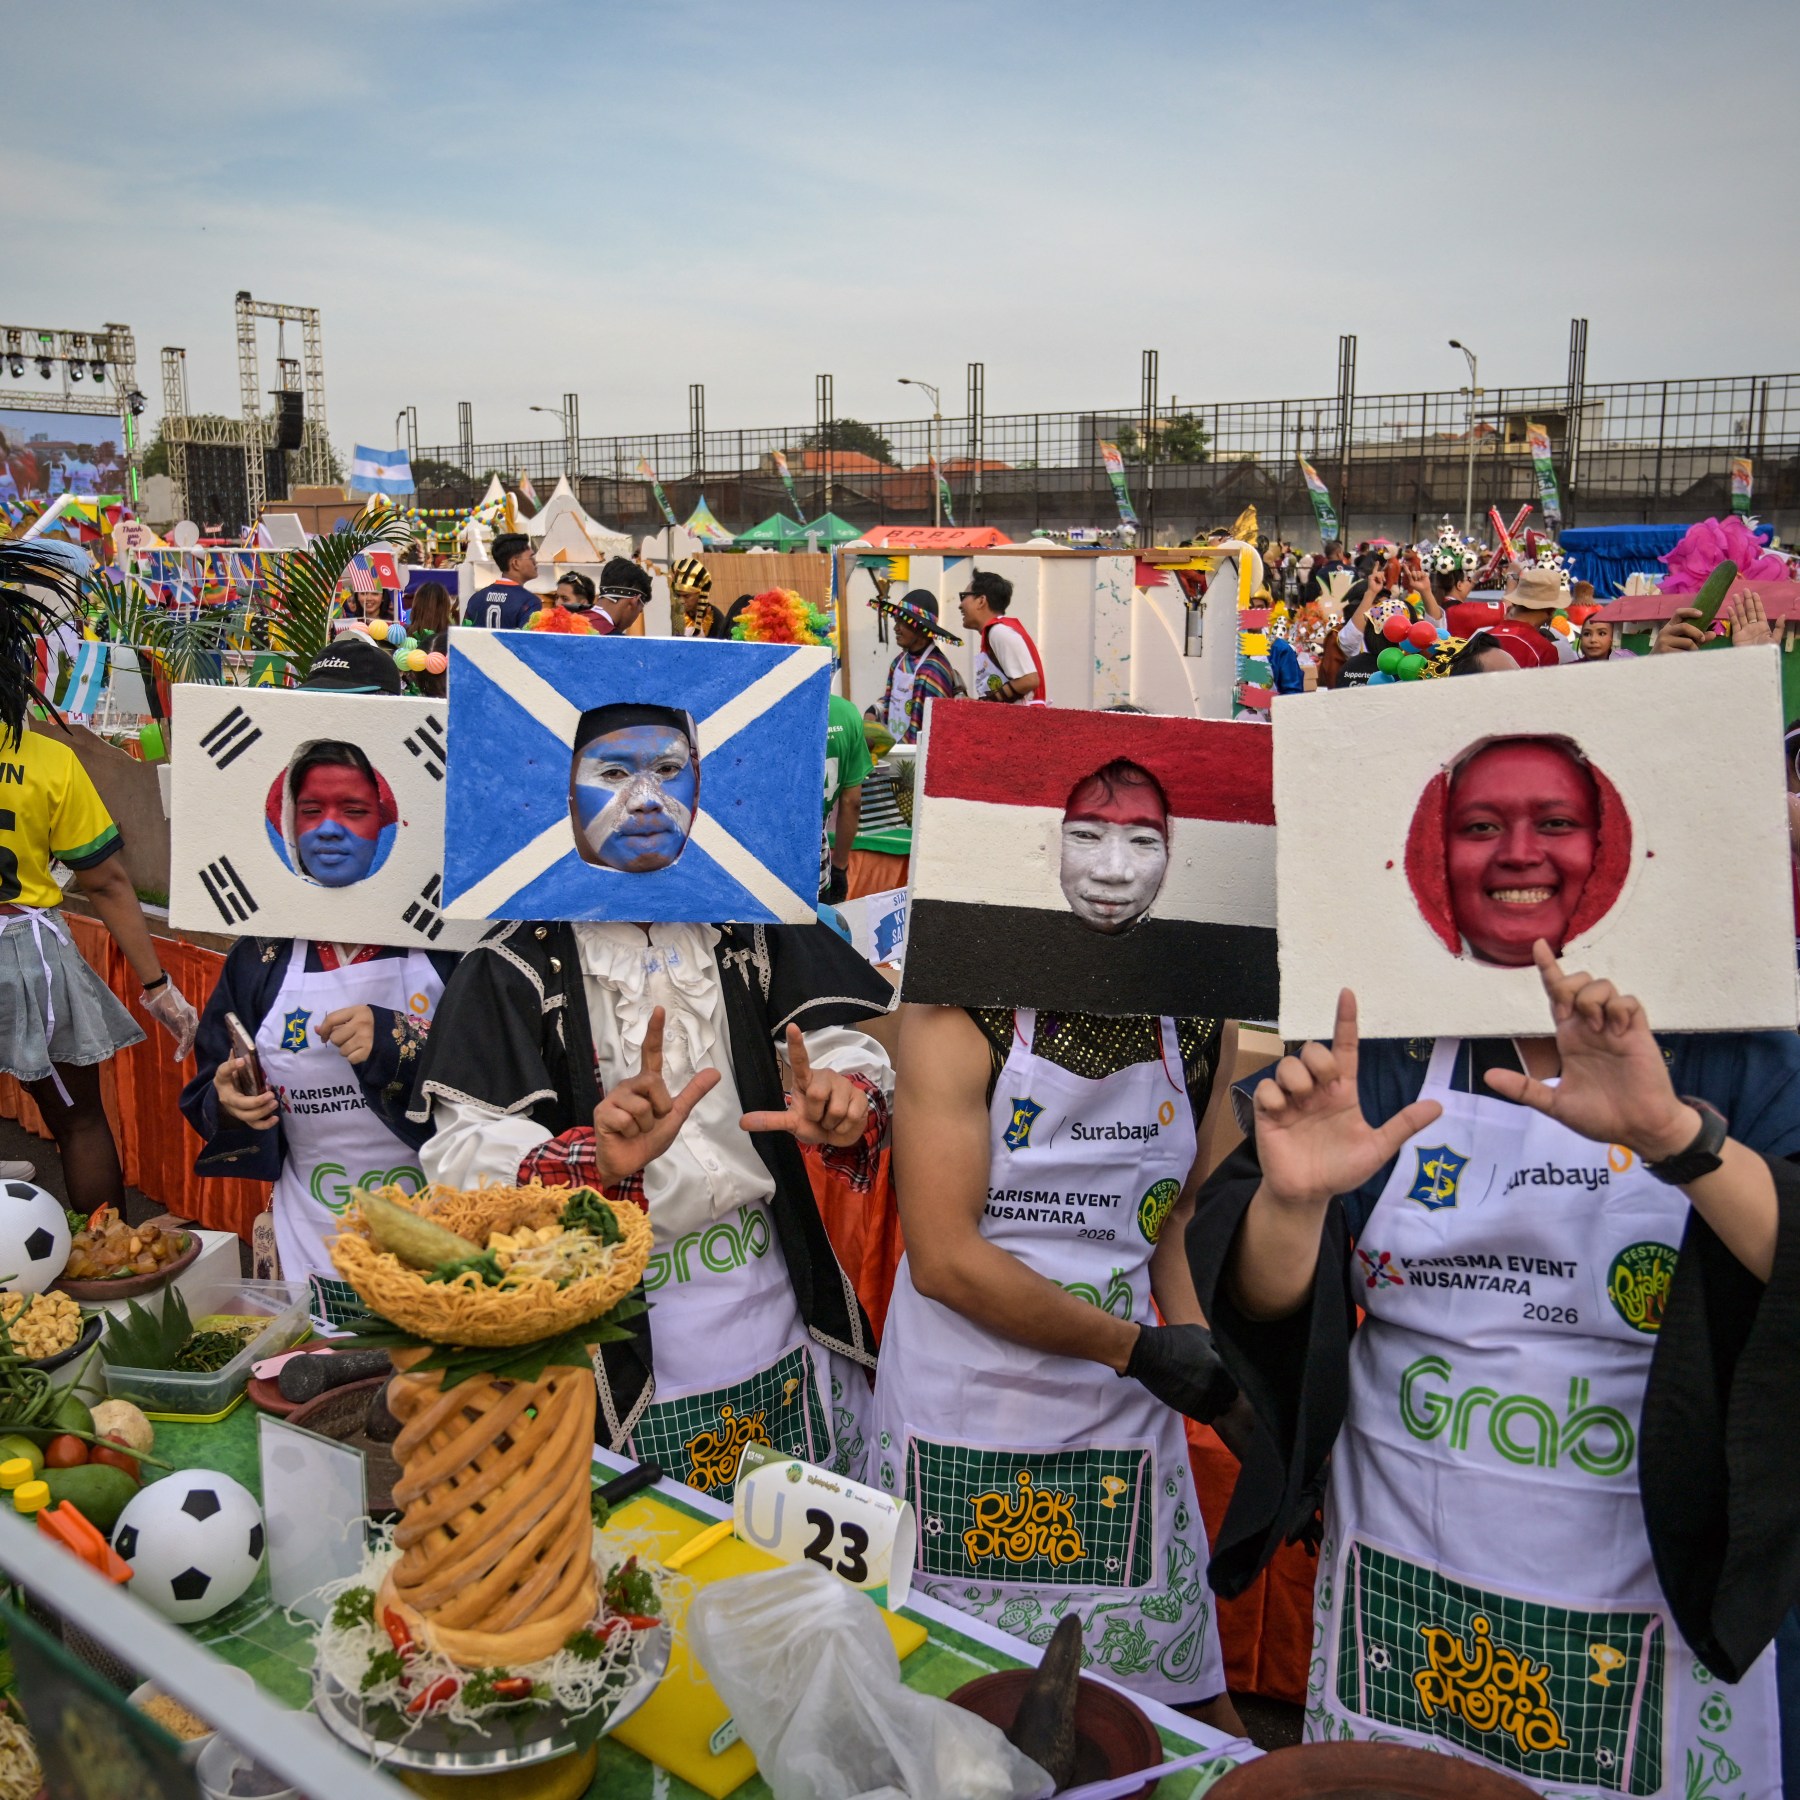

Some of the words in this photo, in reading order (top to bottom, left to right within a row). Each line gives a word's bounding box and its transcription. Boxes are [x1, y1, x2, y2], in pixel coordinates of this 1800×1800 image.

[1343, 671, 1371, 679] Supporte
[826, 725, 844, 733] RESS
[290, 1084, 357, 1101] KARISMA
[293, 1097, 369, 1115] NUSANTAR
[1070, 1121, 1160, 1144] Surabaya
[310, 1161, 429, 1216] Gra
[987, 1187, 1061, 1205] KARISMA
[1064, 1192, 1122, 1208] EVENT
[1076, 1228, 1117, 1241] 2026
[1400, 1253, 1503, 1270] KARISMA
[1506, 1254, 1578, 1279] EVENT
[1622, 1245, 1679, 1265] FESTIVA
[1048, 1266, 1134, 1322] ab
[1408, 1270, 1532, 1297] NUSANTARA
[1522, 1302, 1579, 1325] 2026
[1399, 1355, 1636, 1477] Grab
[803, 1507, 870, 1584] 23
